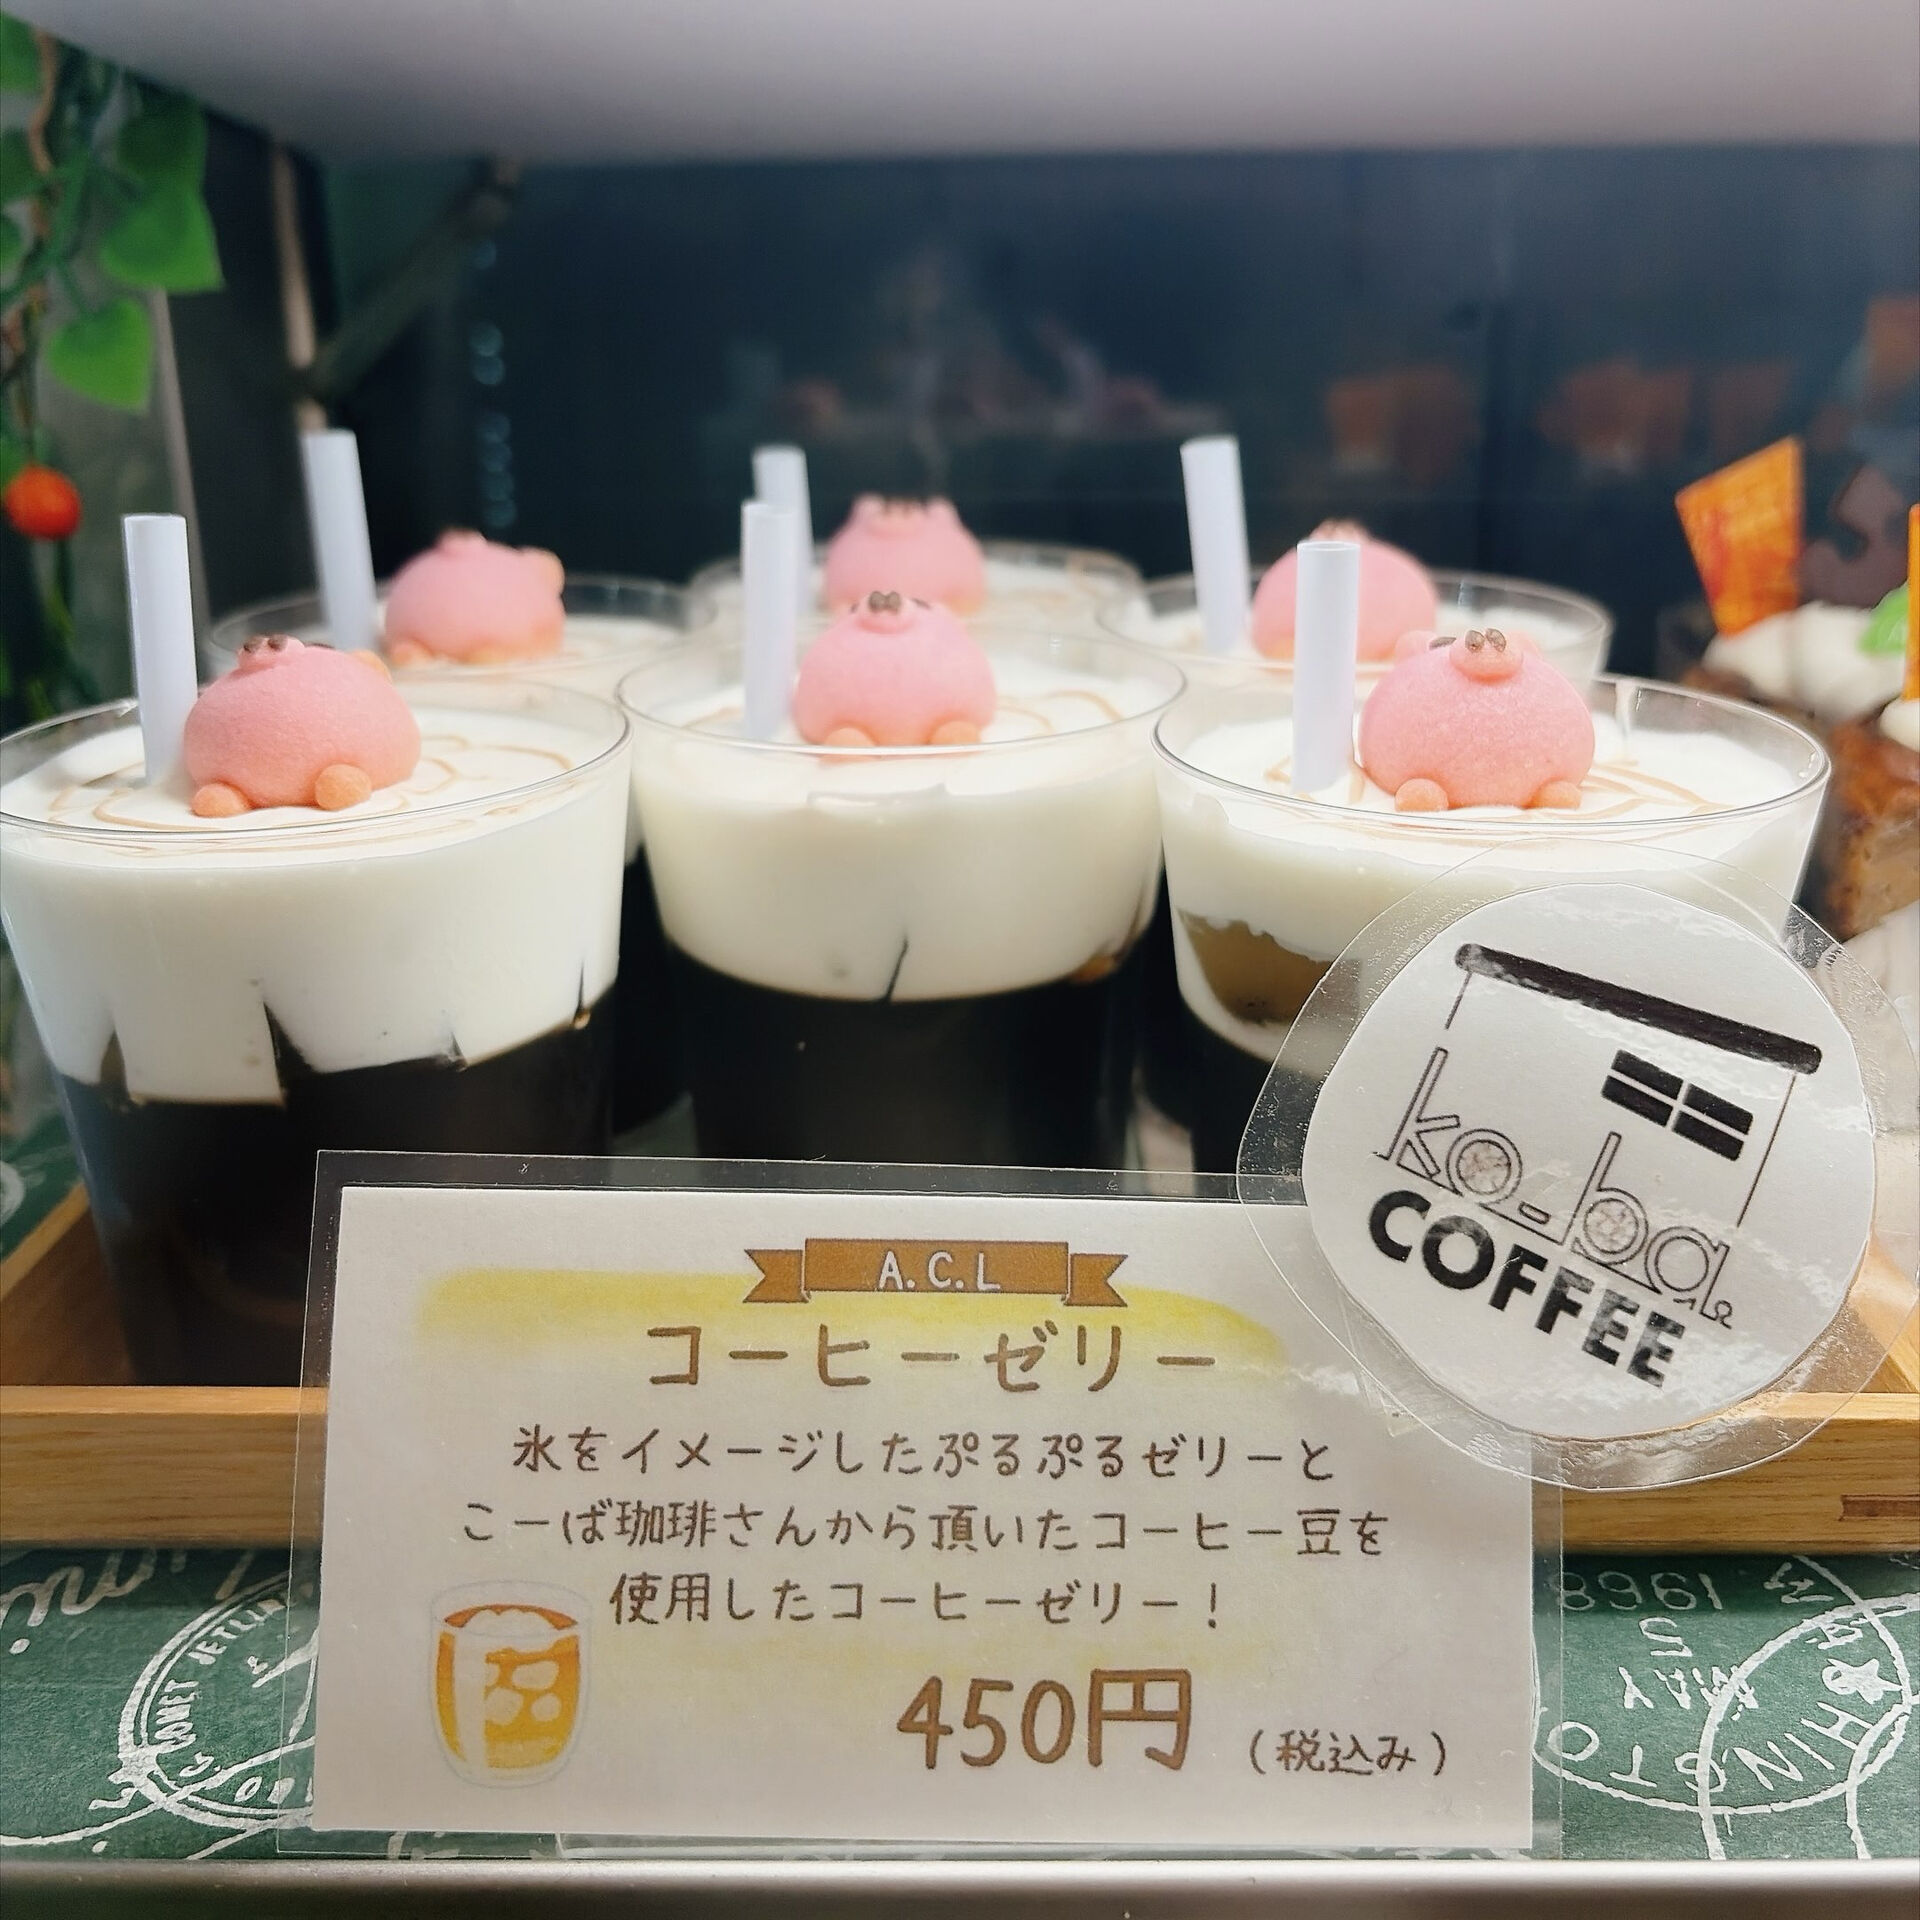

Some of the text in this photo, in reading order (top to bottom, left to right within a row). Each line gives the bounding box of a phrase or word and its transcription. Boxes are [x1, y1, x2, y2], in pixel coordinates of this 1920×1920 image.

[877, 1250, 1001, 1291] A.C.L
[1369, 1188, 1686, 1389] COFFEE
[647, 1320, 1216, 1393] コーヒーゼリー
[512, 1423, 1335, 1482] 氷をイメージしたぷるぷるゼリーと
[462, 1496, 1390, 1557] こーば珈琲さんから頂いたコーヒー豆を
[607, 1571, 1219, 1630] 使用したコーヒーゼリー！
[895, 1667, 1193, 1772] 450円
